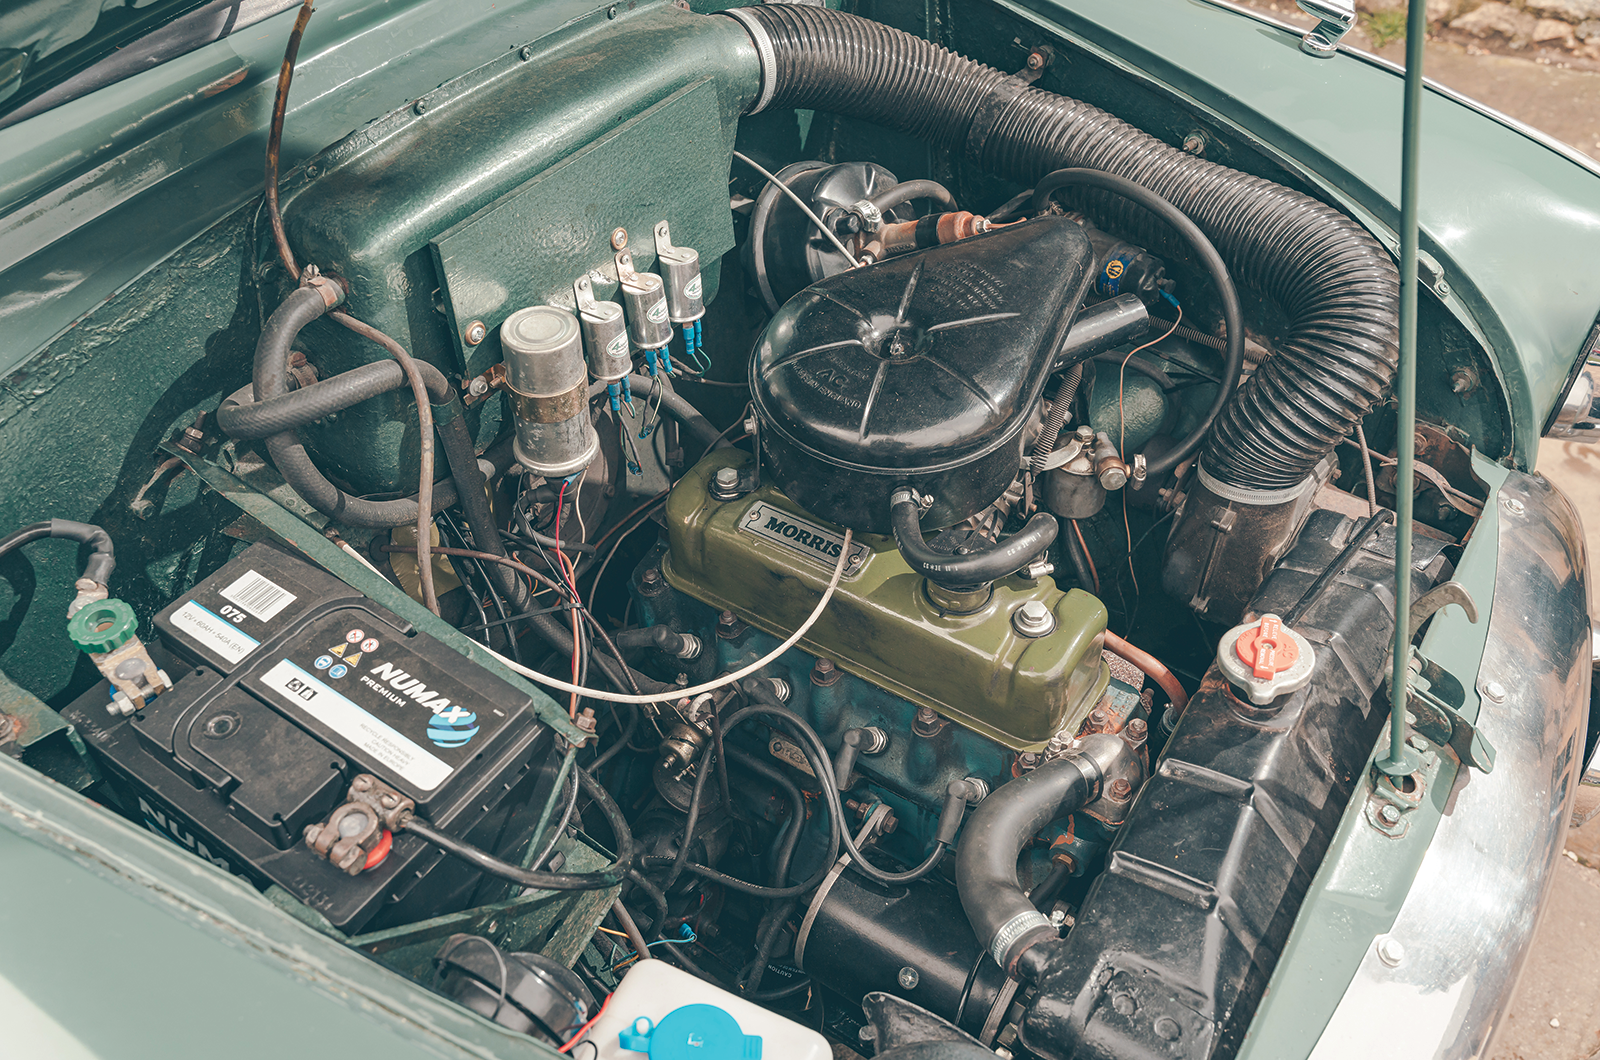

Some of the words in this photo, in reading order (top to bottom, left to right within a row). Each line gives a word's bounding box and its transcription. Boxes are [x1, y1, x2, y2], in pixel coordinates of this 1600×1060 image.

[818, 386, 861, 408] ENGLAND
[764, 516, 843, 558] MORRIS
[220, 605, 247, 623] 075
[182, 611, 195, 622] 12V
[196, 618, 213, 634] 60AH
[214, 633, 231, 645] 540A
[229, 642, 245, 655] (EN)
[360, 675, 407, 707] PREMIUM
[370, 662, 471, 723] NUMAX
[360, 723, 383, 740] RECYCLE
[364, 742, 377, 753] MADE
[383, 756, 404, 770] EUROPE
[371, 739, 393, 755] CAUTION
[392, 753, 409, 766] HEAVY
[138, 797, 254, 886] NUM
[768, 964, 793, 979] CAUTION
